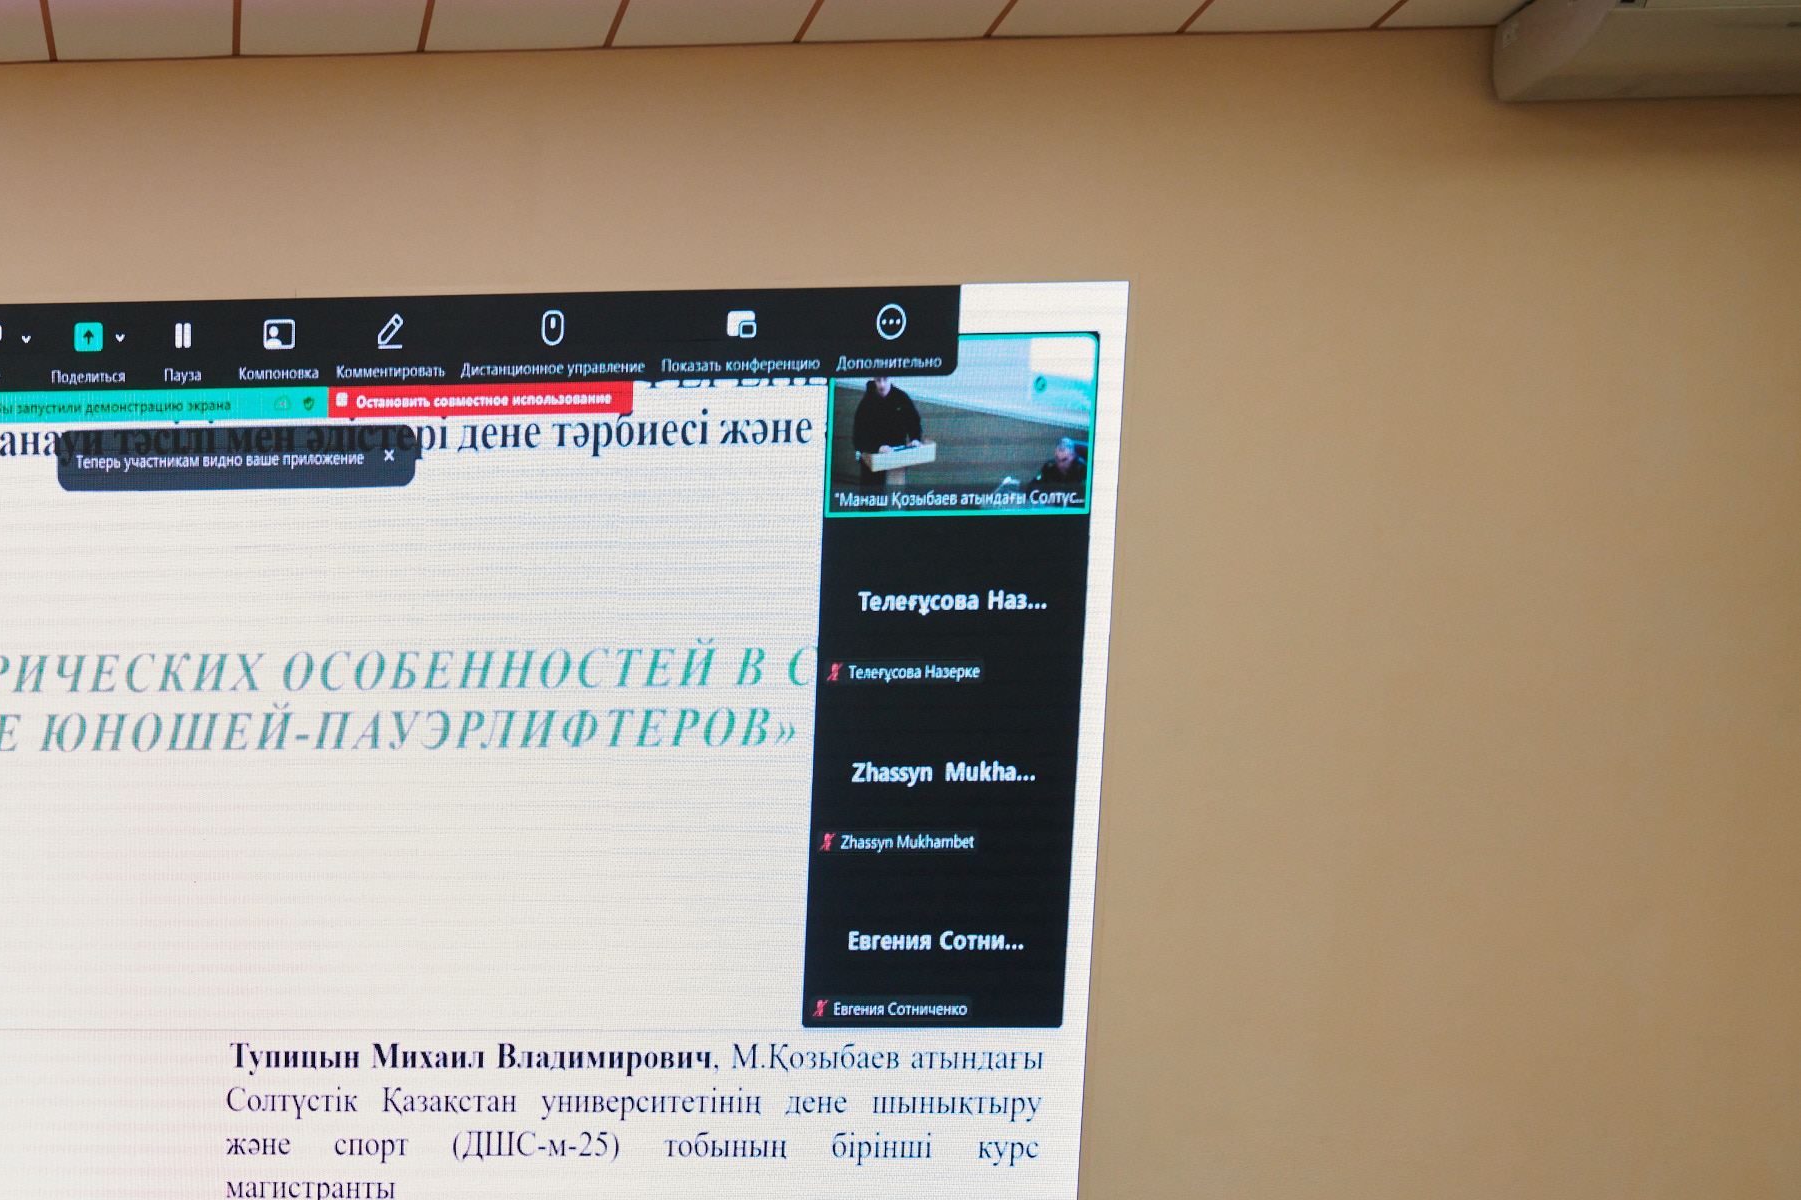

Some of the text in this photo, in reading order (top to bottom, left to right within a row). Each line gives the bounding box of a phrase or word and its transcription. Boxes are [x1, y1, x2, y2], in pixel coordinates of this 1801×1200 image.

[238, 366, 319, 381] Компоновка
[336, 364, 446, 380] Комментировать
[461, 360, 645, 378] Дистанционное управление
[662, 355, 821, 375] Показать конференцию
[836, 356, 942, 373] Дополнительно
[51, 368, 126, 386] Поделиться
[164, 367, 202, 385] Пауза
[17, 401, 82, 415] запустили
[85, 400, 184, 417] демонстрацию
[187, 399, 232, 415] экрана
[356, 391, 612, 409] Остановить совместное использование
[458, 420, 541, 453] дене
[552, 408, 710, 457] тәрбиесі
[720, 416, 812, 447] және
[76, 451, 364, 471] Теперь участникам видно ваше приложение
[987, 590, 1047, 611] Наз...
[282, 638, 716, 693] ОСОБЕННОСТЕЙ
[735, 647, 766, 688] В
[925, 664, 981, 683] Назерке
[39, 702, 796, 755] ЮНОШЕЙ-ПАУЭРЛИФТЕРОВ»
[851, 760, 1036, 787] Zhassyn Mukha...
[840, 834, 975, 853] Zhassyn Mukhambet
[848, 930, 1024, 951] Евгения Сотни...
[833, 1002, 968, 1018] Евгения Сотниченко
[229, 1042, 360, 1076] Тупицын
[371, 1042, 485, 1069] Михаил
[497, 1042, 720, 1077] Владимирович,
[910, 1050, 1043, 1072] атындағы
[226, 1086, 358, 1120] Солтүстік
[540, 1086, 762, 1121] университетінің
[785, 1095, 848, 1116] дене
[225, 1130, 1040, 1167] және спорт (ДШС-м-25) тобының бірінші курс
